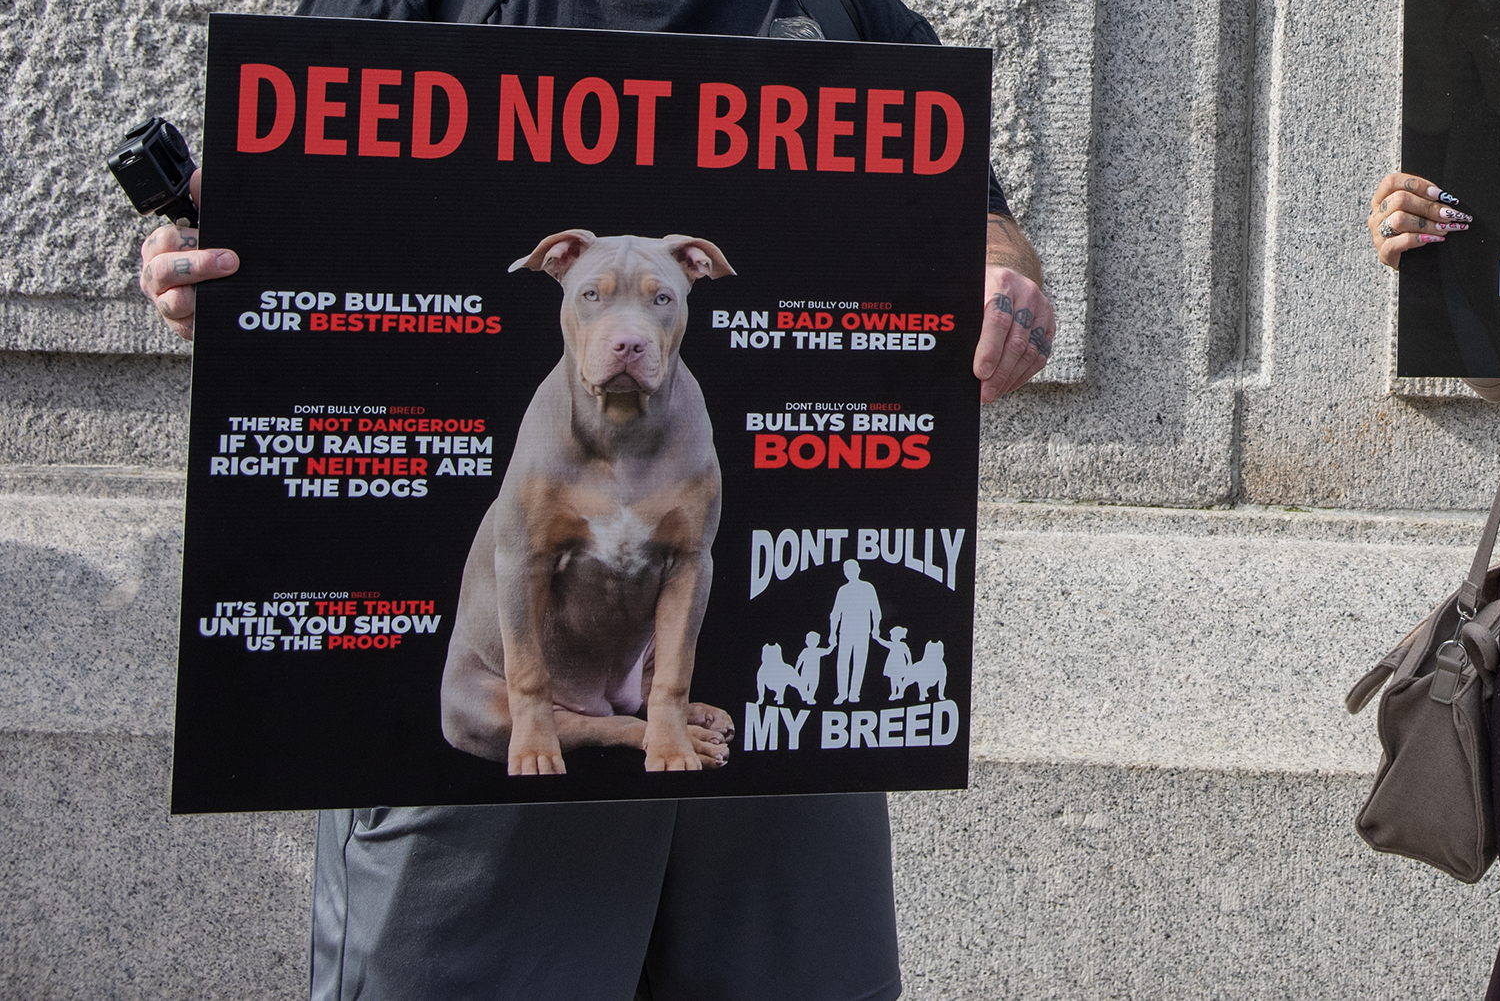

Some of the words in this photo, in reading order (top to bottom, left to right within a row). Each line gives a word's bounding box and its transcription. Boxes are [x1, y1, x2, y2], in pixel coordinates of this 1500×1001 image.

[236, 63, 468, 159] DEED
[497, 74, 672, 166] NOT
[697, 82, 965, 175] BREED
[260, 291, 336, 310] STOP
[345, 292, 482, 313] BULLYING
[779, 301, 805, 309] DONT
[808, 301, 837, 309] BULLY
[838, 301, 859, 309] OUR
[861, 302, 892, 310] BREED
[238, 311, 301, 331] OUR
[310, 313, 501, 334] BESTFRIENDS
[712, 310, 769, 329] BAN
[777, 311, 833, 330] BAD
[841, 312, 955, 332] OWNERS
[730, 331, 786, 349] NOT
[792, 331, 843, 350] THE
[850, 332, 936, 351] BREED
[294, 405, 325, 414] DONT
[327, 405, 361, 414] BULLY
[363, 405, 387, 414] OUR
[389, 406, 425, 415] BREED
[785, 402, 813, 411] DONT
[815, 402, 845, 411] BULLY
[846, 403, 867, 411] OUR
[869, 403, 901, 411] BREED
[228, 416, 303, 432] THE'RE
[308, 418, 352, 432] NOT
[358, 418, 486, 433] DANGEROUS
[746, 413, 845, 432] BULLYS
[852, 413, 934, 432] BRING
[219, 434, 246, 453] IF
[254, 434, 314, 454] YOU
[323, 435, 407, 454] RAISE
[415, 436, 493, 454] THEM
[754, 434, 931, 469] BONDS
[210, 456, 299, 476] RIGHT
[306, 457, 428, 476] NEITHER
[435, 458, 493, 476] ARE
[284, 478, 339, 498] THE
[348, 478, 428, 498] DOGS
[750, 529, 848, 600] DONT
[857, 529, 965, 591] BULLY
[351, 591, 380, 599] BREED
[215, 601, 257, 617] IT'S
[262, 601, 309, 617] NOT
[315, 601, 357, 615] THE
[363, 600, 435, 615] TRUTH
[199, 617, 281, 636] UNTIL
[288, 616, 347, 635] YOU
[354, 615, 442, 634] SHOW
[246, 636, 275, 651] US
[280, 636, 323, 651] THE
[328, 634, 402, 650] PROOF
[744, 702, 811, 751] MY
[821, 700, 959, 749] BREED
